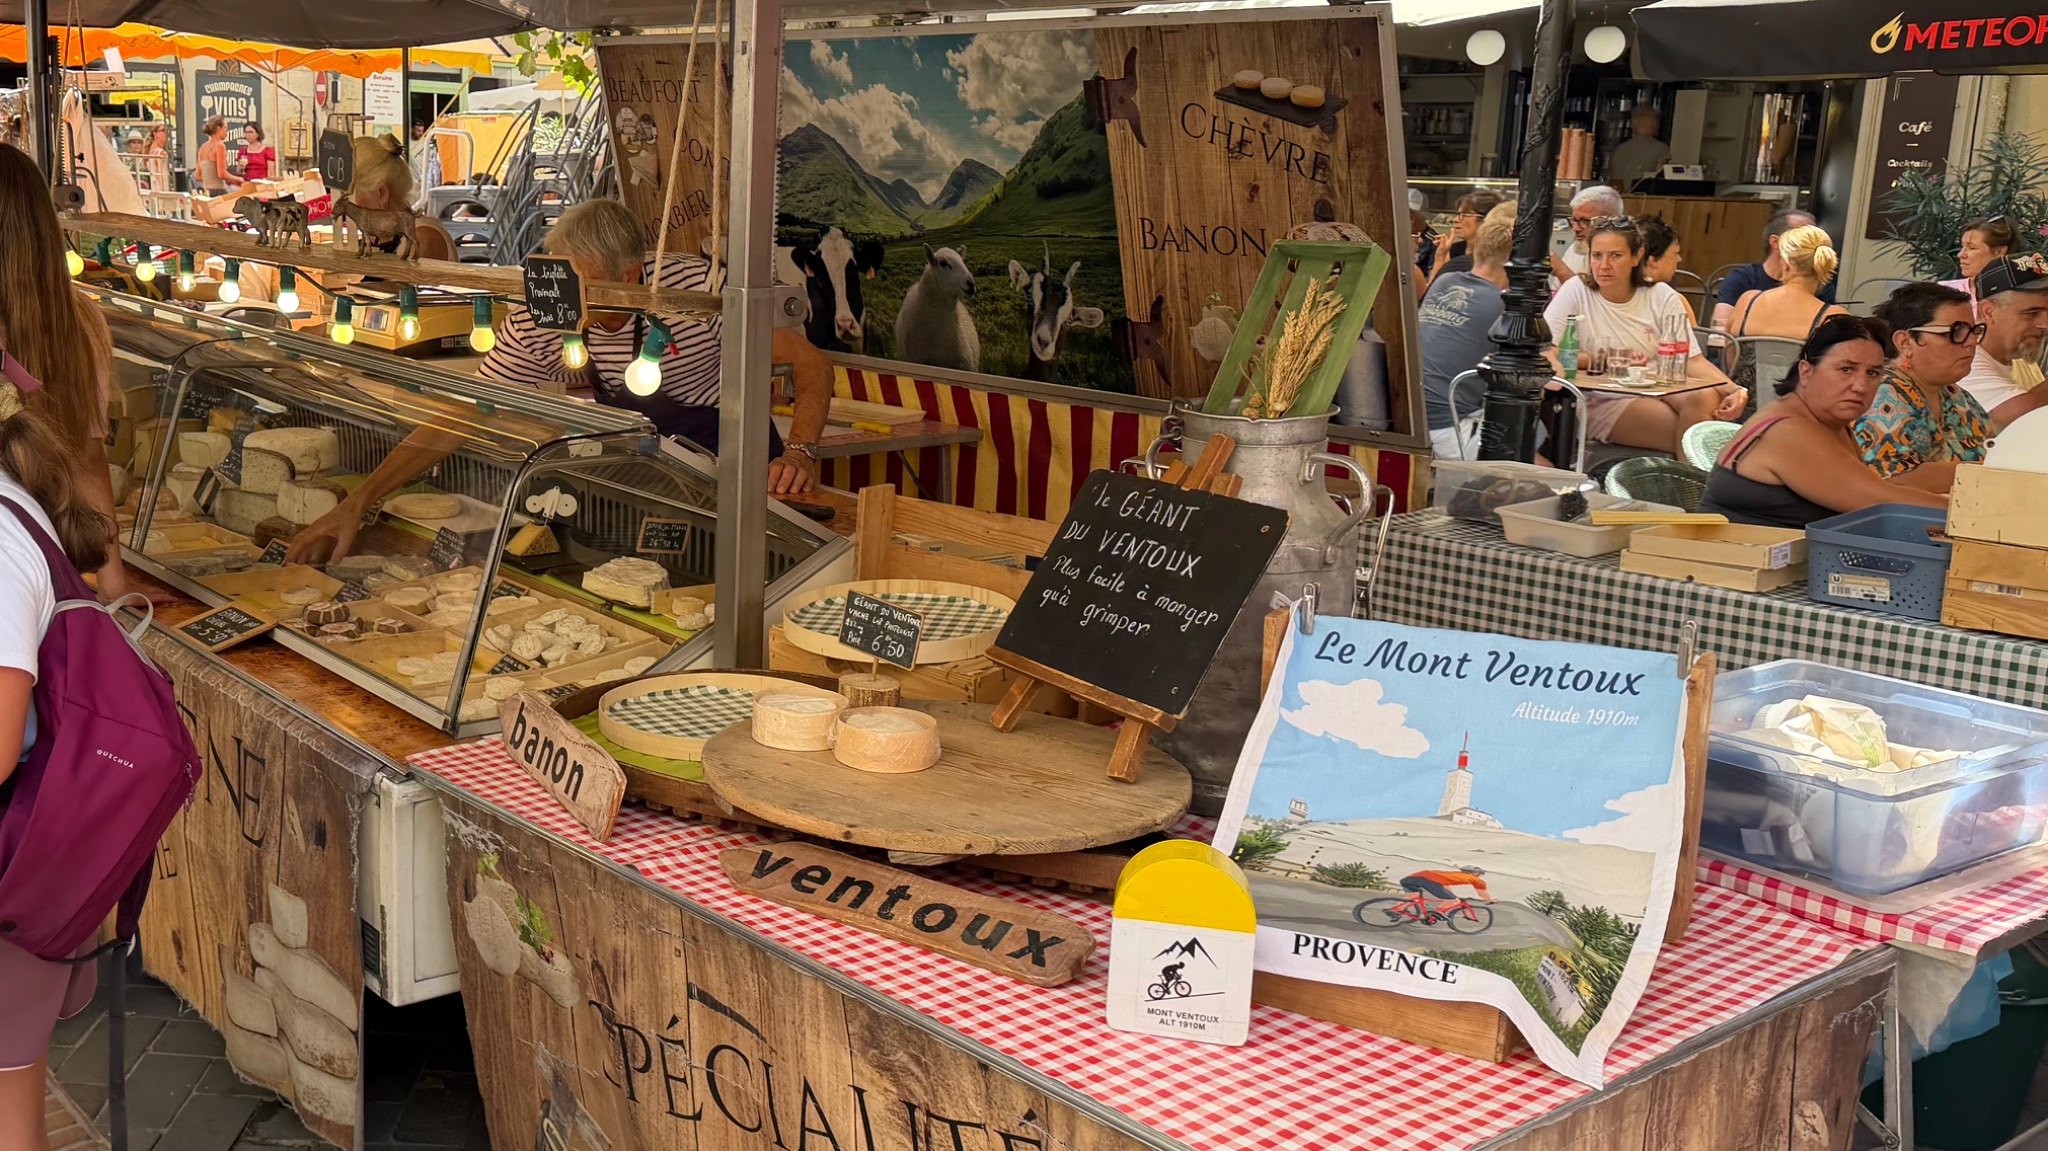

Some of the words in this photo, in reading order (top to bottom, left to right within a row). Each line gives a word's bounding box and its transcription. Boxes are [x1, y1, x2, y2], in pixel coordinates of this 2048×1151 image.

[204, 81, 253, 96] CHAMPAGNES
[213, 96, 247, 117] VINS
[1898, 121, 1933, 135] Café
[1181, 103, 1330, 184] CHÈVRE
[327, 156, 345, 182] CB
[1887, 159, 1933, 168] Cocktails
[1139, 217, 1267, 257] BANON
[1119, 488, 1200, 531] GÉANT
[1062, 520, 1091, 540] DU
[1098, 530, 1202, 578] VENTOUX
[853, 596, 880, 612] GÉANT
[880, 607, 890, 615] DU
[1040, 585, 1072, 608] qu'à
[1080, 604, 1150, 636] grimper
[1087, 565, 1126, 593] facile
[1136, 585, 1150, 601] à
[1154, 596, 1219, 632] manger
[848, 607, 870, 620] VACHE
[1314, 631, 1356, 664] Le
[1363, 638, 1472, 679] Mont
[1485, 650, 1645, 696] Ventoux
[1511, 701, 1580, 724] Altitude
[1586, 708, 1640, 726] 1910m
[96, 749, 134, 768] QUECHUA
[509, 701, 584, 802] banon
[750, 849, 1066, 968] ventoux
[1292, 933, 1460, 984] PROVENCE
[1147, 1007, 1173, 1017] MONT
[1176, 1011, 1219, 1023] VENTOUX
[1159, 1018, 1176, 1026] ALT
[1179, 1021, 1206, 1031] 1910M
